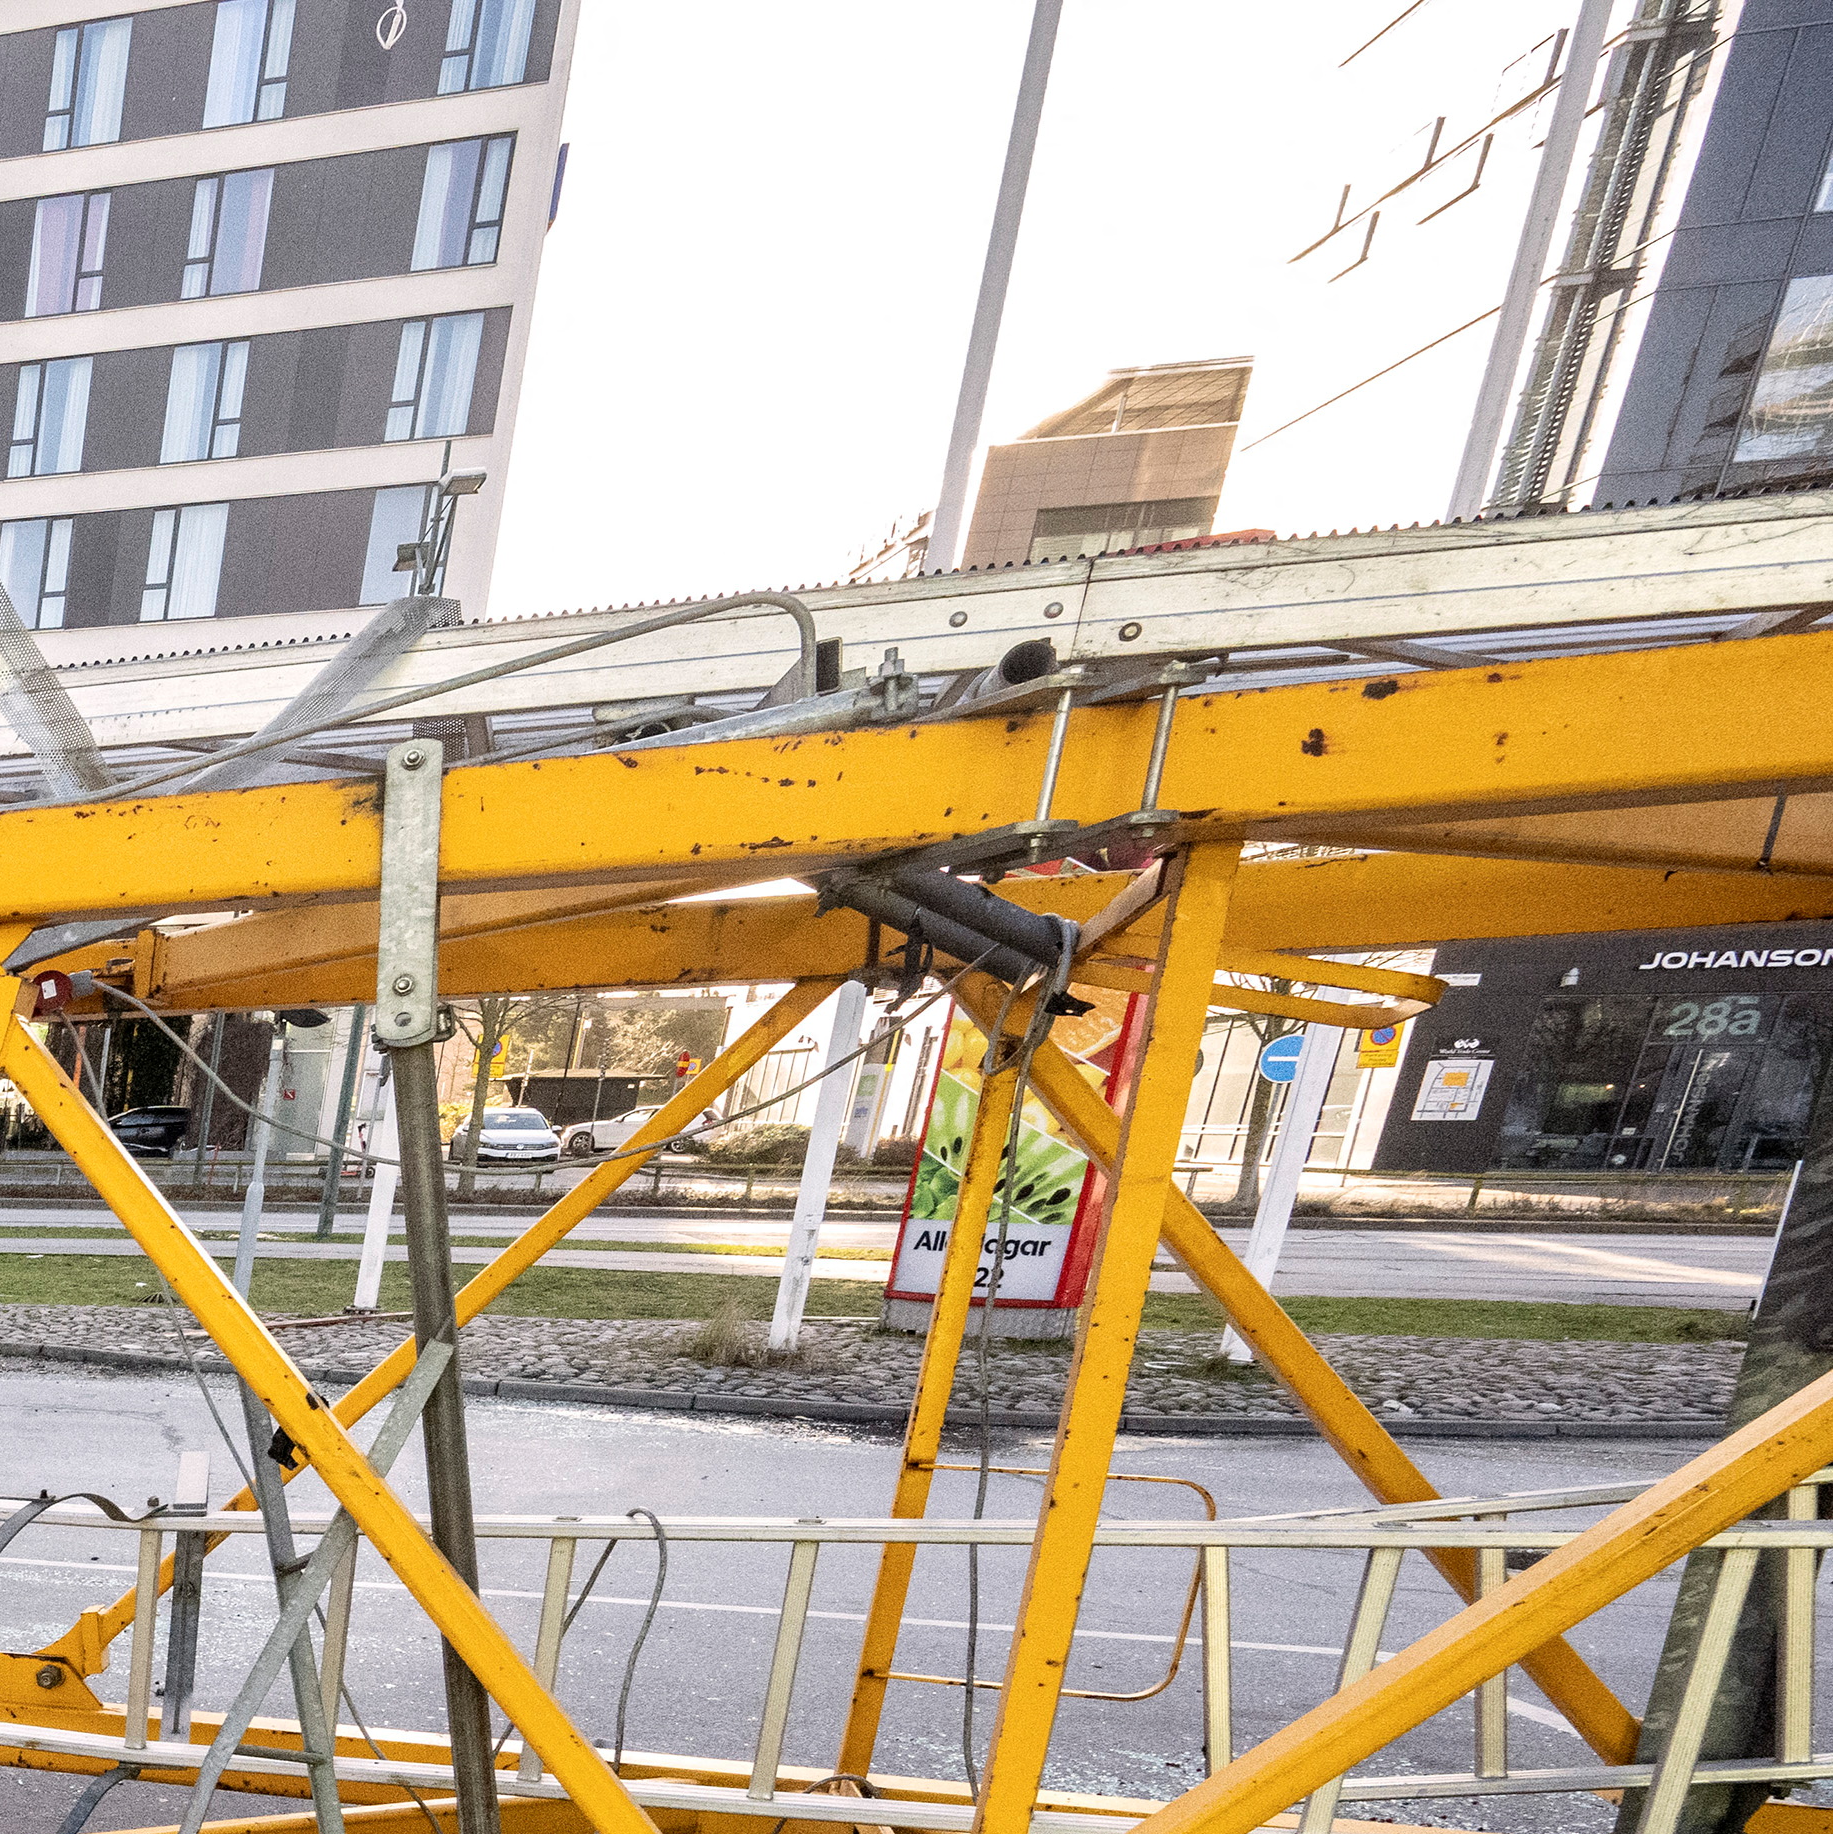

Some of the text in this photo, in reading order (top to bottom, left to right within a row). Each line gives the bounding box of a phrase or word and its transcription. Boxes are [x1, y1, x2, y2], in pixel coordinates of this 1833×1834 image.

[1663, 1001, 1762, 1036] 28a
[913, 1230, 1052, 1260] All agar
